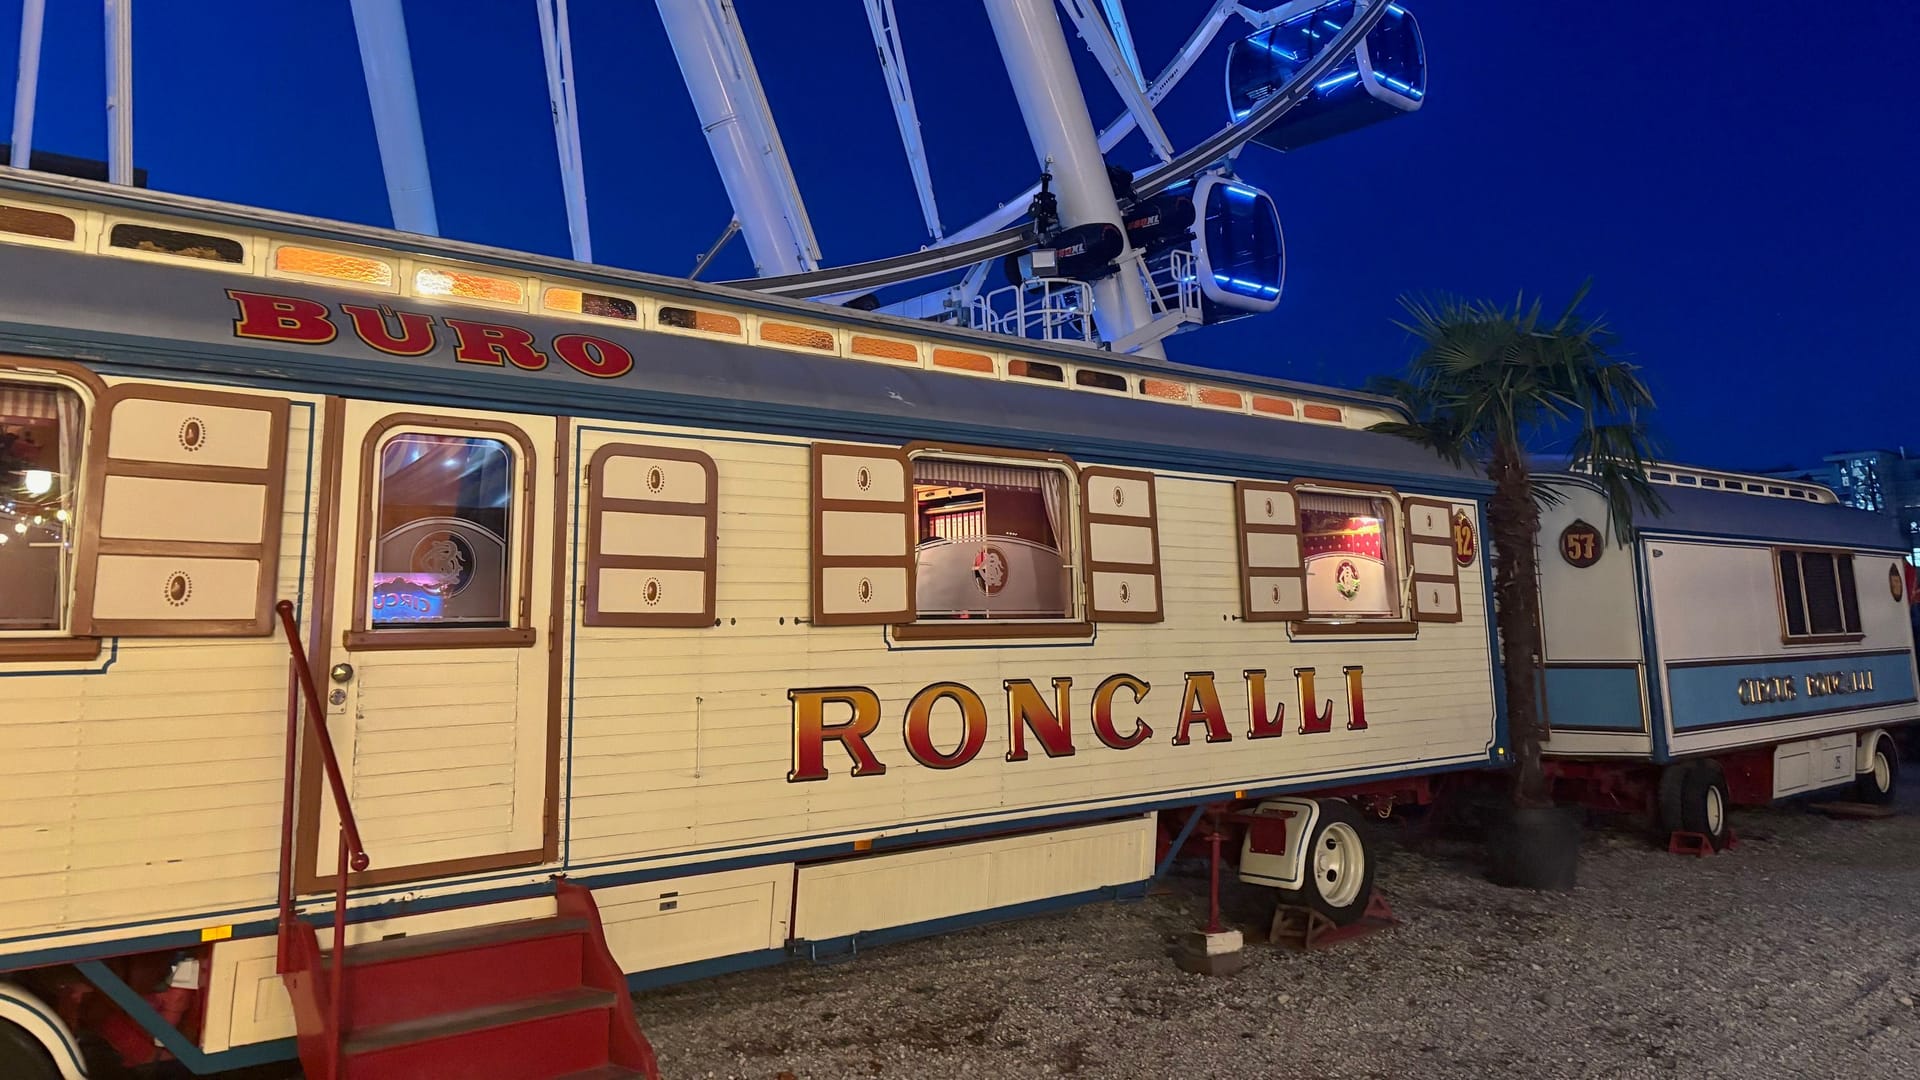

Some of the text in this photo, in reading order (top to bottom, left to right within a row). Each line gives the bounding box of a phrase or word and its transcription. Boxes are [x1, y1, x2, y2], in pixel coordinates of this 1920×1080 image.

[224, 289, 635, 378] BÜRO
[1567, 533, 1595, 560] 57
[787, 665, 1368, 782] RONCALLI
